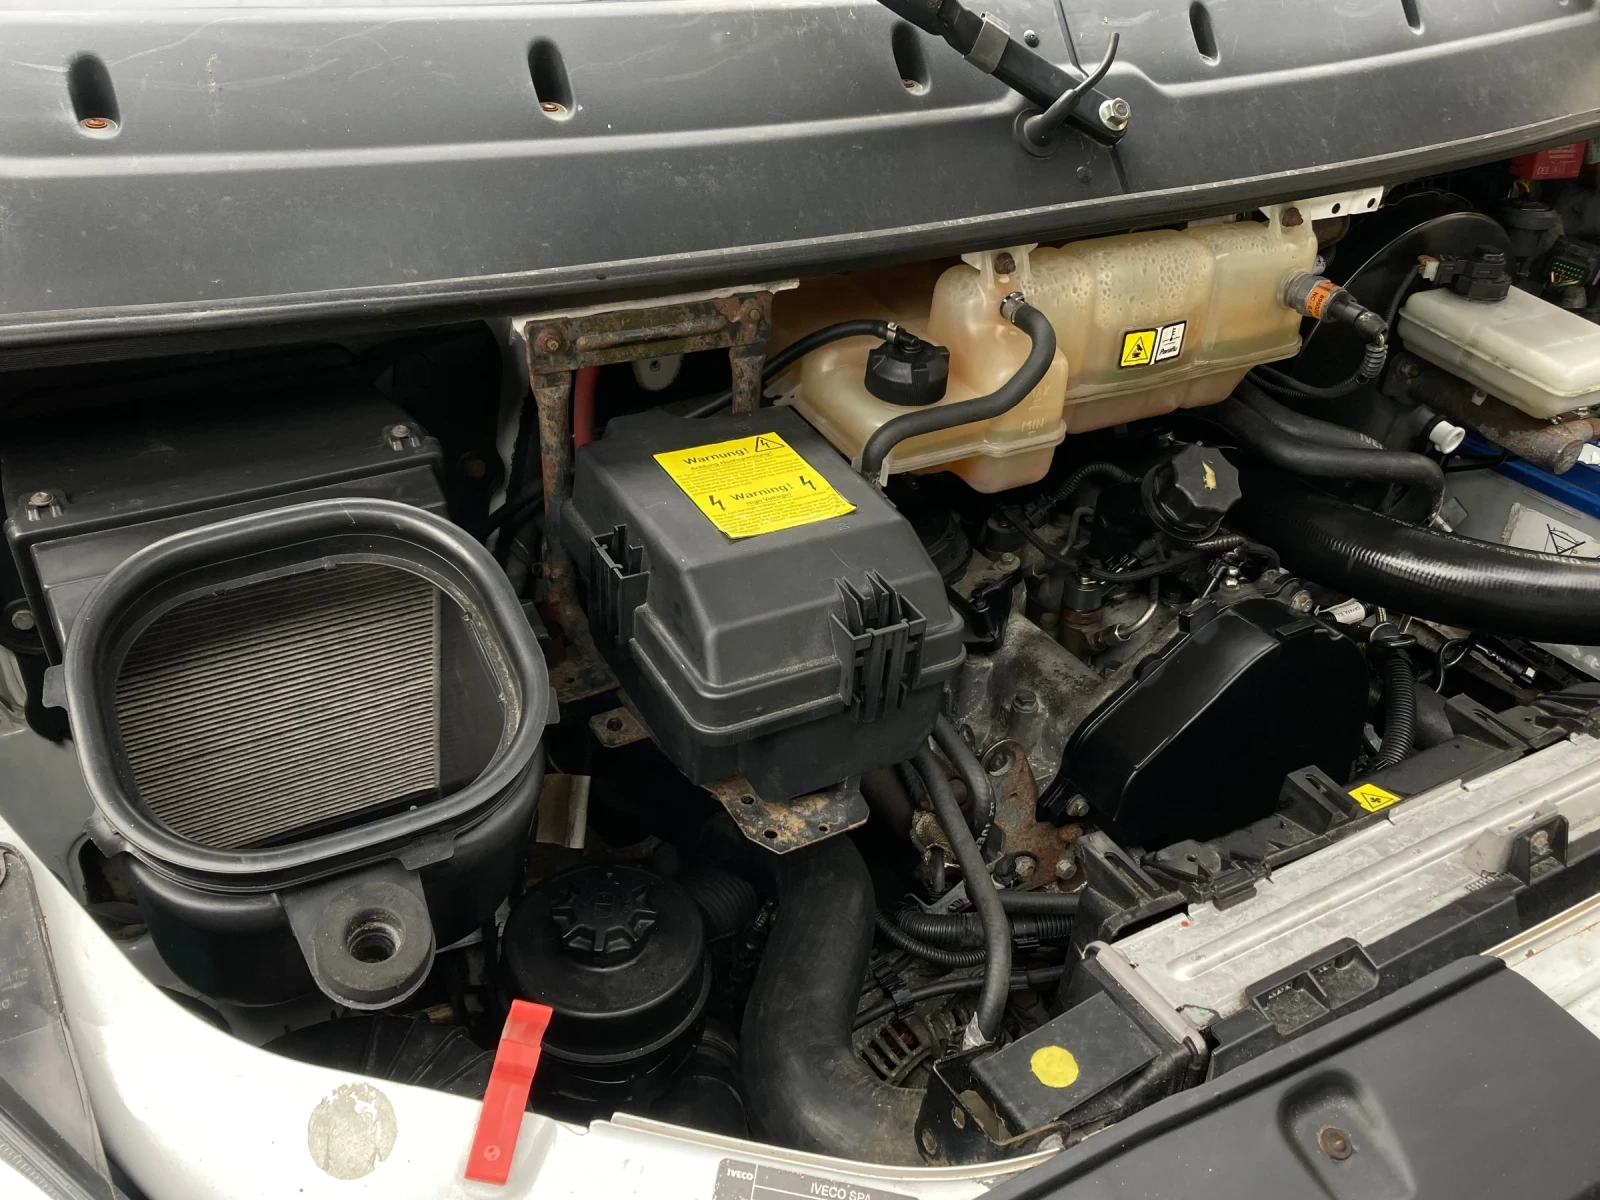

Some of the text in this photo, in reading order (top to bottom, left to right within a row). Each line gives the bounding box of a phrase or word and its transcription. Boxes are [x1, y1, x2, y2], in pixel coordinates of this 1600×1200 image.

[1021, 417, 1045, 432] MIN
[683, 447, 749, 464] Warnung!
[730, 482, 793, 501] Warning!
[727, 1167, 754, 1181] IVECO
[810, 1182, 847, 1200] IVECO
